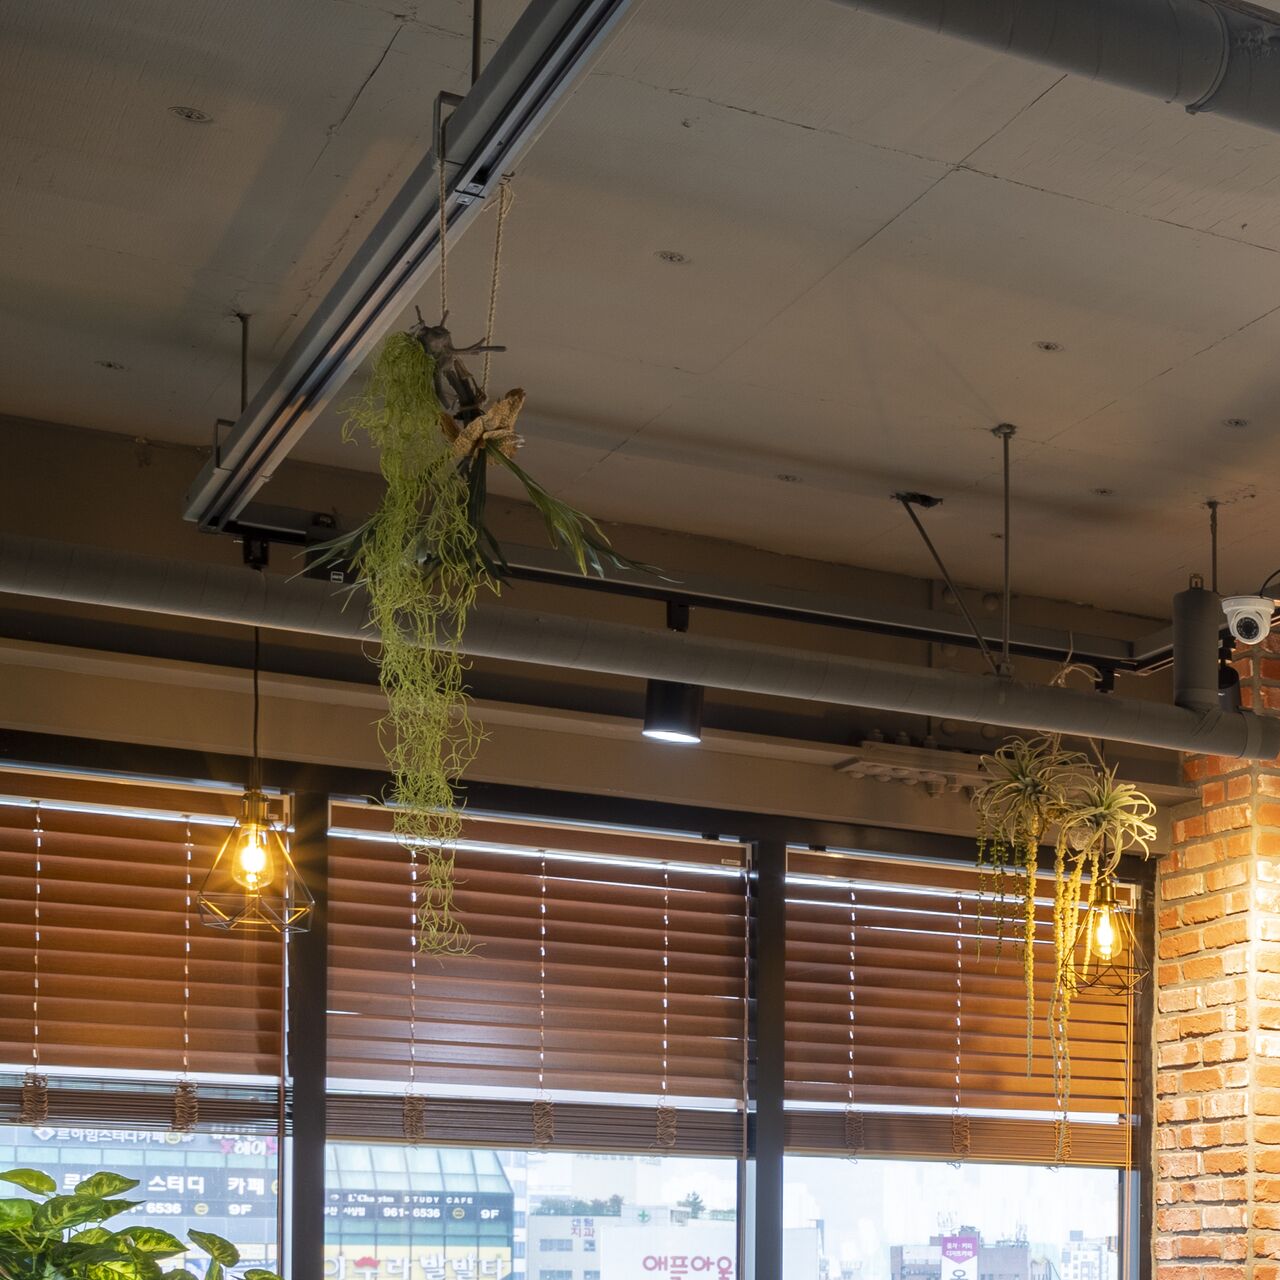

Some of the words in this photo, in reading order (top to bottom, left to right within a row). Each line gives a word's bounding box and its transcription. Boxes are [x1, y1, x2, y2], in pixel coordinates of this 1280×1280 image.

[147, 1174, 205, 1194] 스터디
[227, 1176, 265, 1196] 카페
[446, 1196, 474, 1205] CAFE
[145, 1202, 183, 1215] 6536
[228, 1203, 253, 1216] 9F
[480, 1208, 500, 1219] 9F
